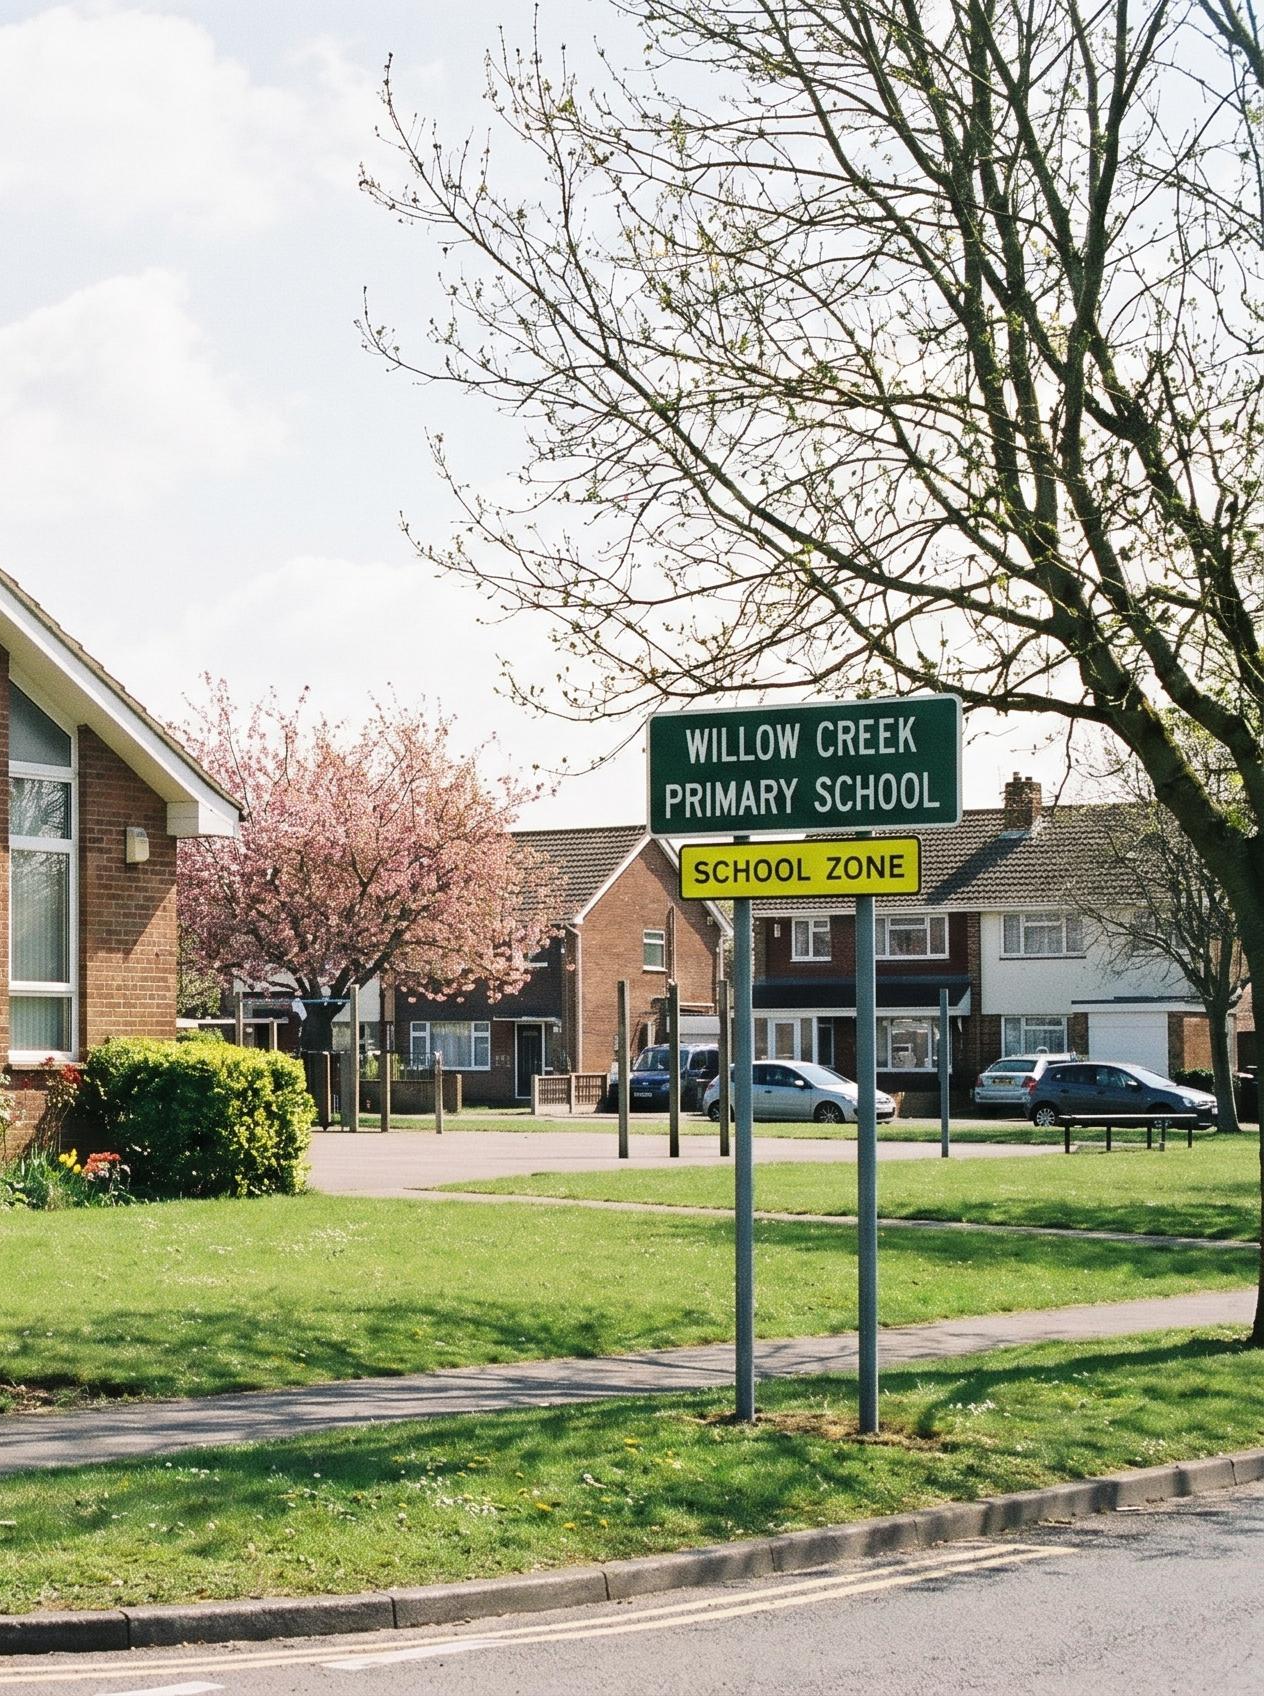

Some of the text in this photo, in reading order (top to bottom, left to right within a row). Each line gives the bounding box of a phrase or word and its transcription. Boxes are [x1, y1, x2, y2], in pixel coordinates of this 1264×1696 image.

[685, 716, 917, 764] WILLOW CREEK
[665, 771, 941, 819] PRIMARY SCHOOL
[693, 854, 905, 885] SCHOOL ZONE
